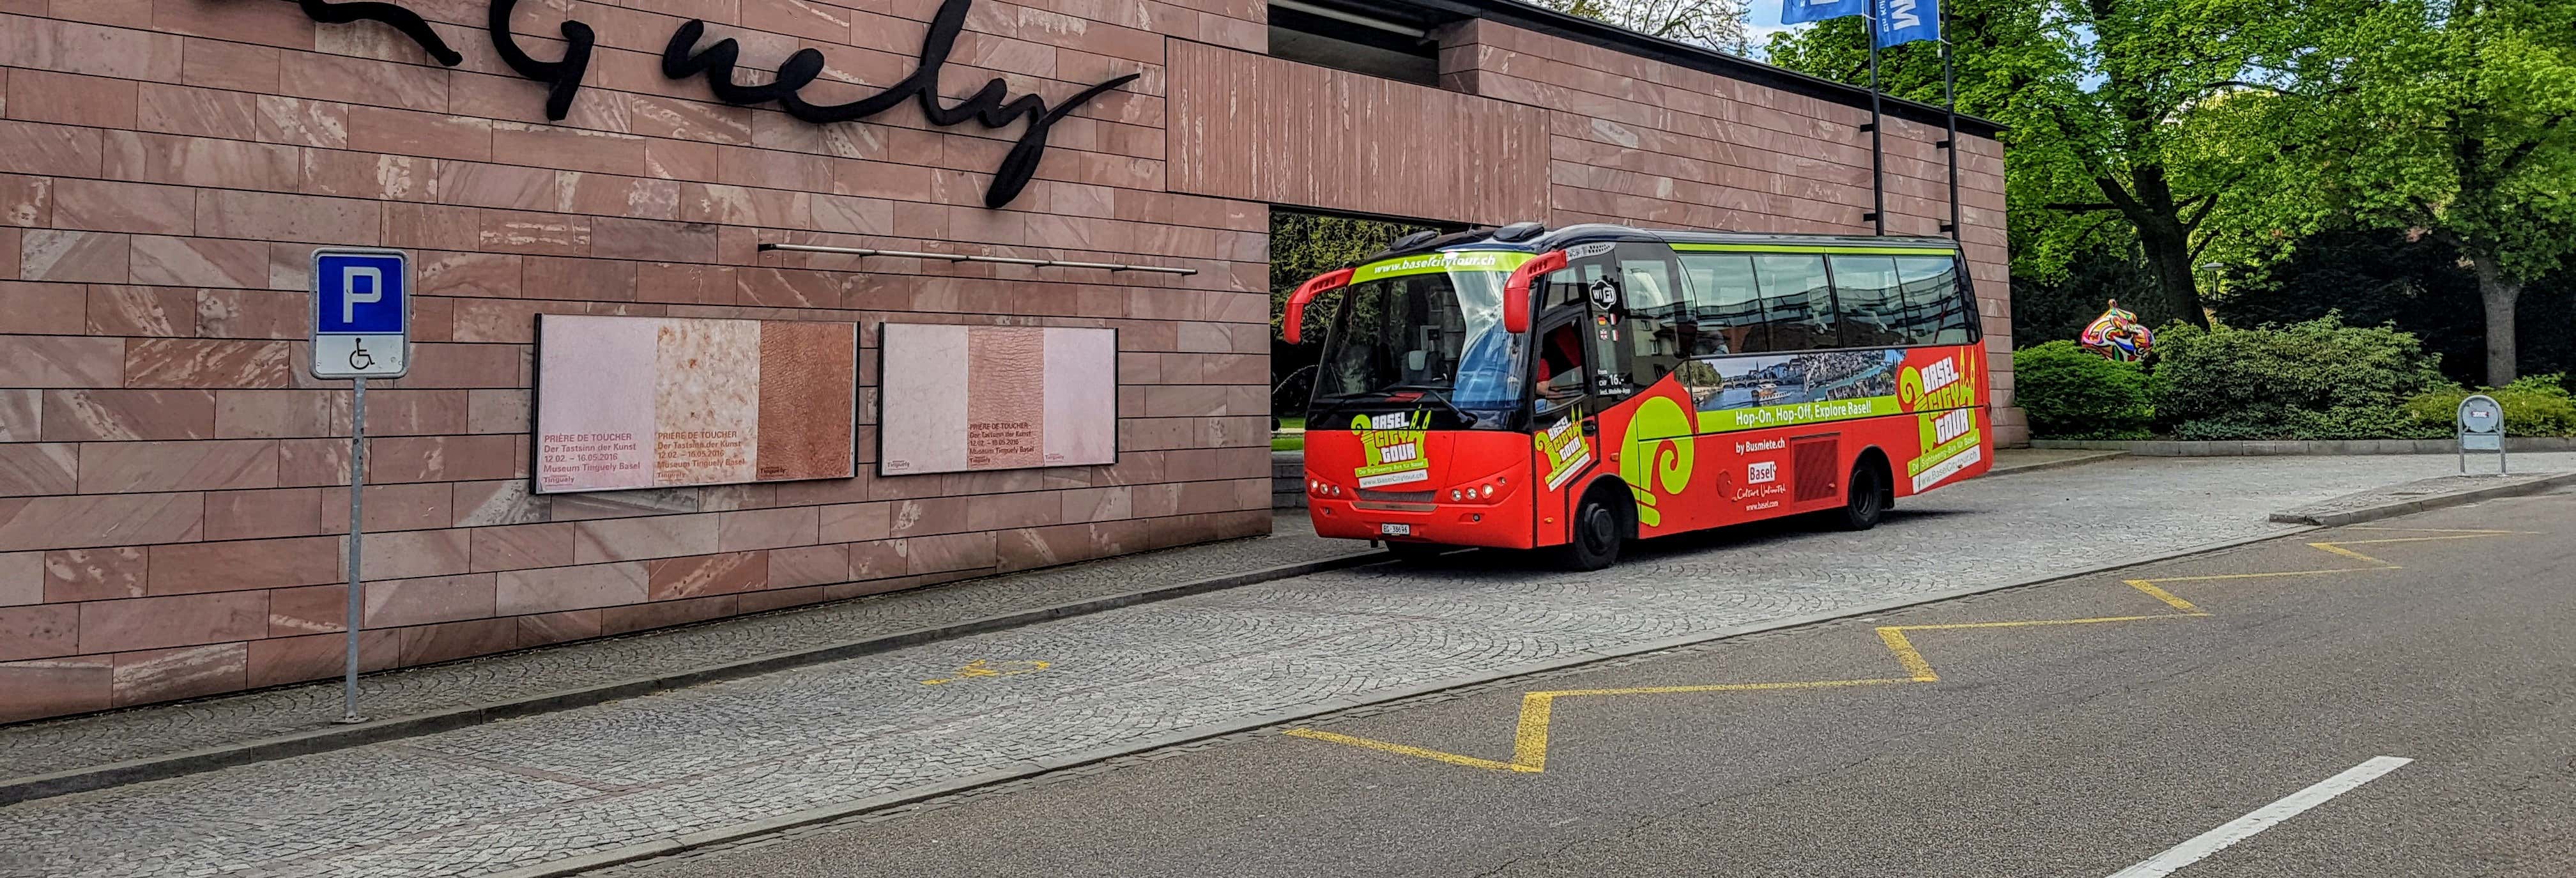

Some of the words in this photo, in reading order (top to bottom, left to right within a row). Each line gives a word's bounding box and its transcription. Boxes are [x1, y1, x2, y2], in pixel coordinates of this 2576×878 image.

[1374, 254, 1496, 274] www.baselcitytour.ch
[343, 266, 381, 323] P
[1921, 355, 1959, 394] BASEL
[1372, 412, 1409, 430] BASEL
[1735, 409, 1774, 427] Hop-On,
[1776, 404, 1813, 424] Hop-Off,
[1814, 403, 1846, 419] Explore
[1848, 400, 1871, 415] Basel!
[1547, 415, 1572, 441] BASEL
[1736, 442, 1745, 456] by
[582, 463, 617, 472] Tinguely
[619, 461, 640, 470] Basel
[692, 459, 723, 468] Tinguely
[1750, 463, 1774, 481] Basel
[543, 475, 574, 484] Tinguely
[1746, 500, 1779, 511] www.basel.com
